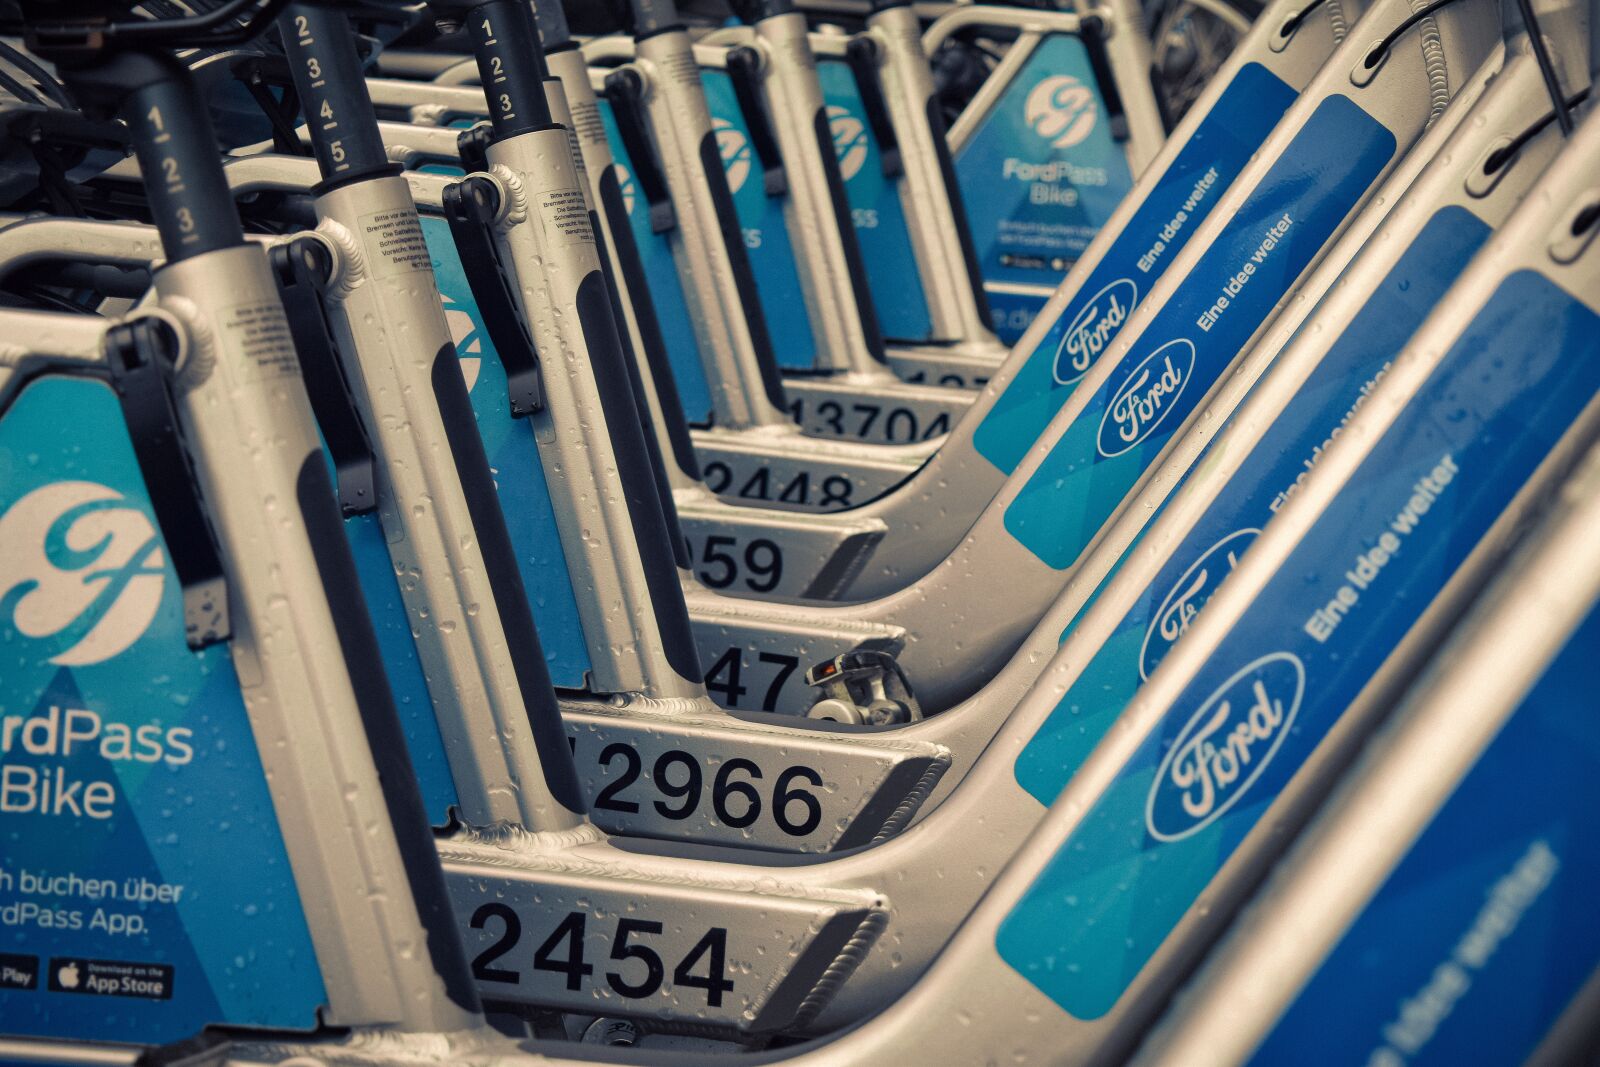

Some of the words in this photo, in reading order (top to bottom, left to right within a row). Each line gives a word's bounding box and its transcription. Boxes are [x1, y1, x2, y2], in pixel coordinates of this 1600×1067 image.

[294, 16, 310, 37] 2
[482, 19, 494, 38] 1
[307, 58, 322, 79] 3
[490, 57, 504, 76] 2
[148, 106, 162, 132] 1
[320, 99, 335, 121] 4
[500, 93, 513, 113] 3
[331, 141, 346, 162] 5
[162, 158, 181, 183] 2
[178, 208, 193, 234] 3
[1136, 240, 1166, 273] Eine
[1159, 211, 1187, 243] Idee
[1182, 166, 1219, 213] weiter
[1196, 294, 1230, 332] Eine
[1224, 260, 1256, 300] Idee
[1252, 212, 1294, 264] weiter
[1066, 294, 1126, 371] Ford
[1113, 356, 1181, 441] Ford
[703, 461, 853, 506] 2448
[687, 534, 783, 594] 59
[1304, 585, 1359, 643] Eine
[1345, 531, 1401, 590] Idee
[1391, 454, 1459, 535] weiter
[704, 647, 799, 712] 47
[1171, 680, 1283, 817] Ford
[0, 764, 116, 821] Bike
[567, 736, 824, 837] 2966
[20, 869, 117, 899] buchen
[123, 876, 183, 904] über
[88, 907, 148, 937] App.
[469, 903, 734, 1008] 2454
[2, 967, 33, 987] Play
[86, 974, 119, 994] App
[121, 976, 164, 995] Store
